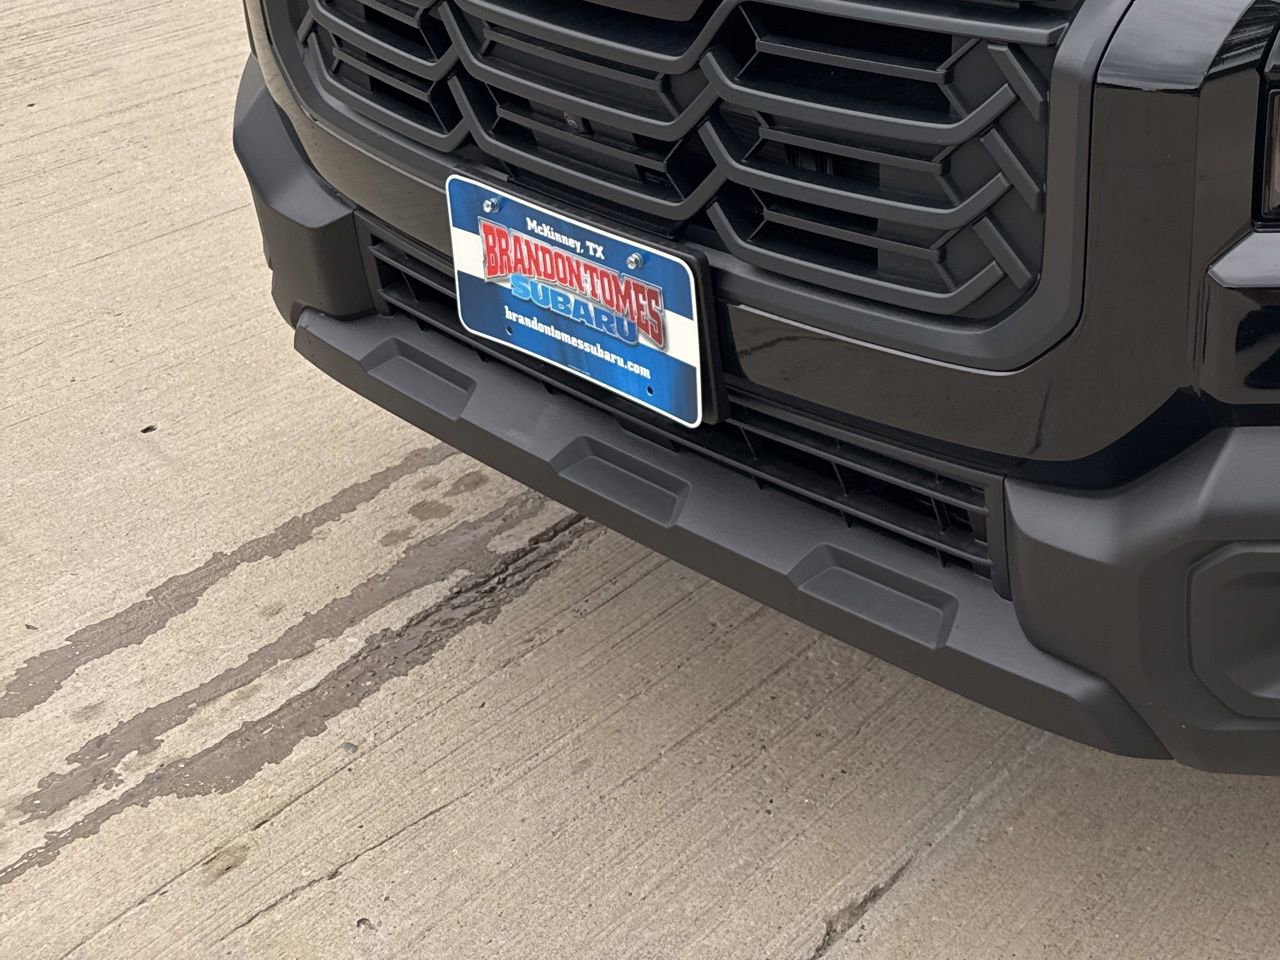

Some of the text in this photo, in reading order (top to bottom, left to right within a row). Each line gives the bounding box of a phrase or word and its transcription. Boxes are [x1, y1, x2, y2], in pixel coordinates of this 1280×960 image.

[526, 217, 605, 259] McKinney, TX
[480, 219, 666, 349] BRANDON TOMES
[510, 272, 639, 345] SUBARU
[504, 305, 651, 380] brandontomessubaru.com
